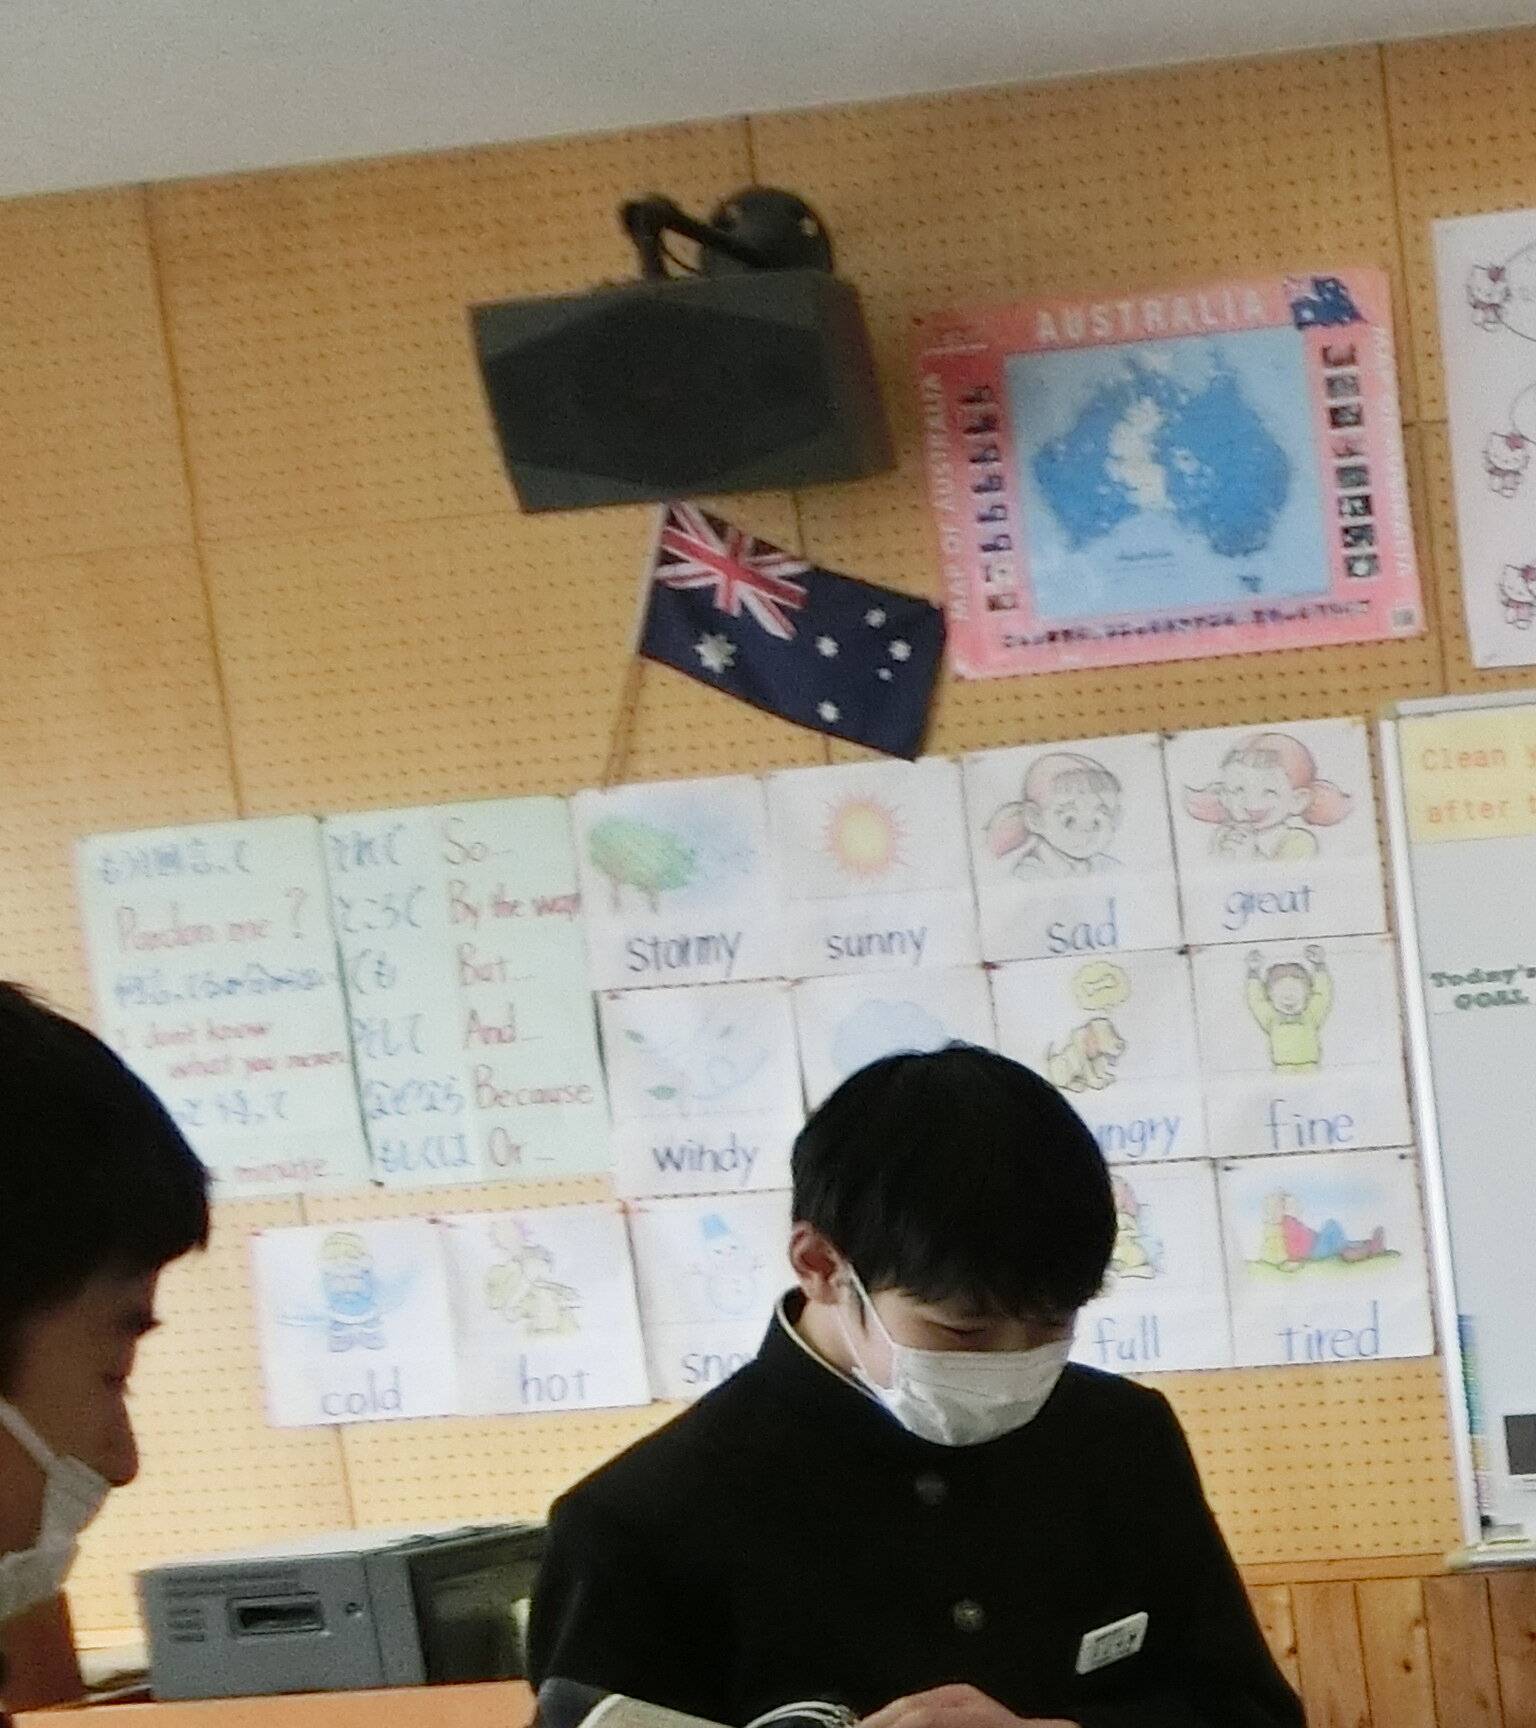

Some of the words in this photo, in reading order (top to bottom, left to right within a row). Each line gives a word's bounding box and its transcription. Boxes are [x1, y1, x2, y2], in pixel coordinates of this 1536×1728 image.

[1036, 291, 1262, 344] AUSTRALIA
[1421, 747, 1506, 771] Clean
[1427, 800, 1511, 825] after
[449, 878, 480, 928] By
[491, 881, 527, 919] the
[1046, 895, 1120, 955] sad
[1220, 884, 1316, 932] great
[826, 924, 928, 967] sunny
[473, 1062, 596, 1110] Because
[1262, 1097, 1356, 1151] fine
[650, 1130, 761, 1188] windy
[1092, 1313, 1161, 1364] full
[1274, 1299, 1382, 1362] tired
[320, 1366, 402, 1418] cold
[518, 1352, 592, 1406] hot
